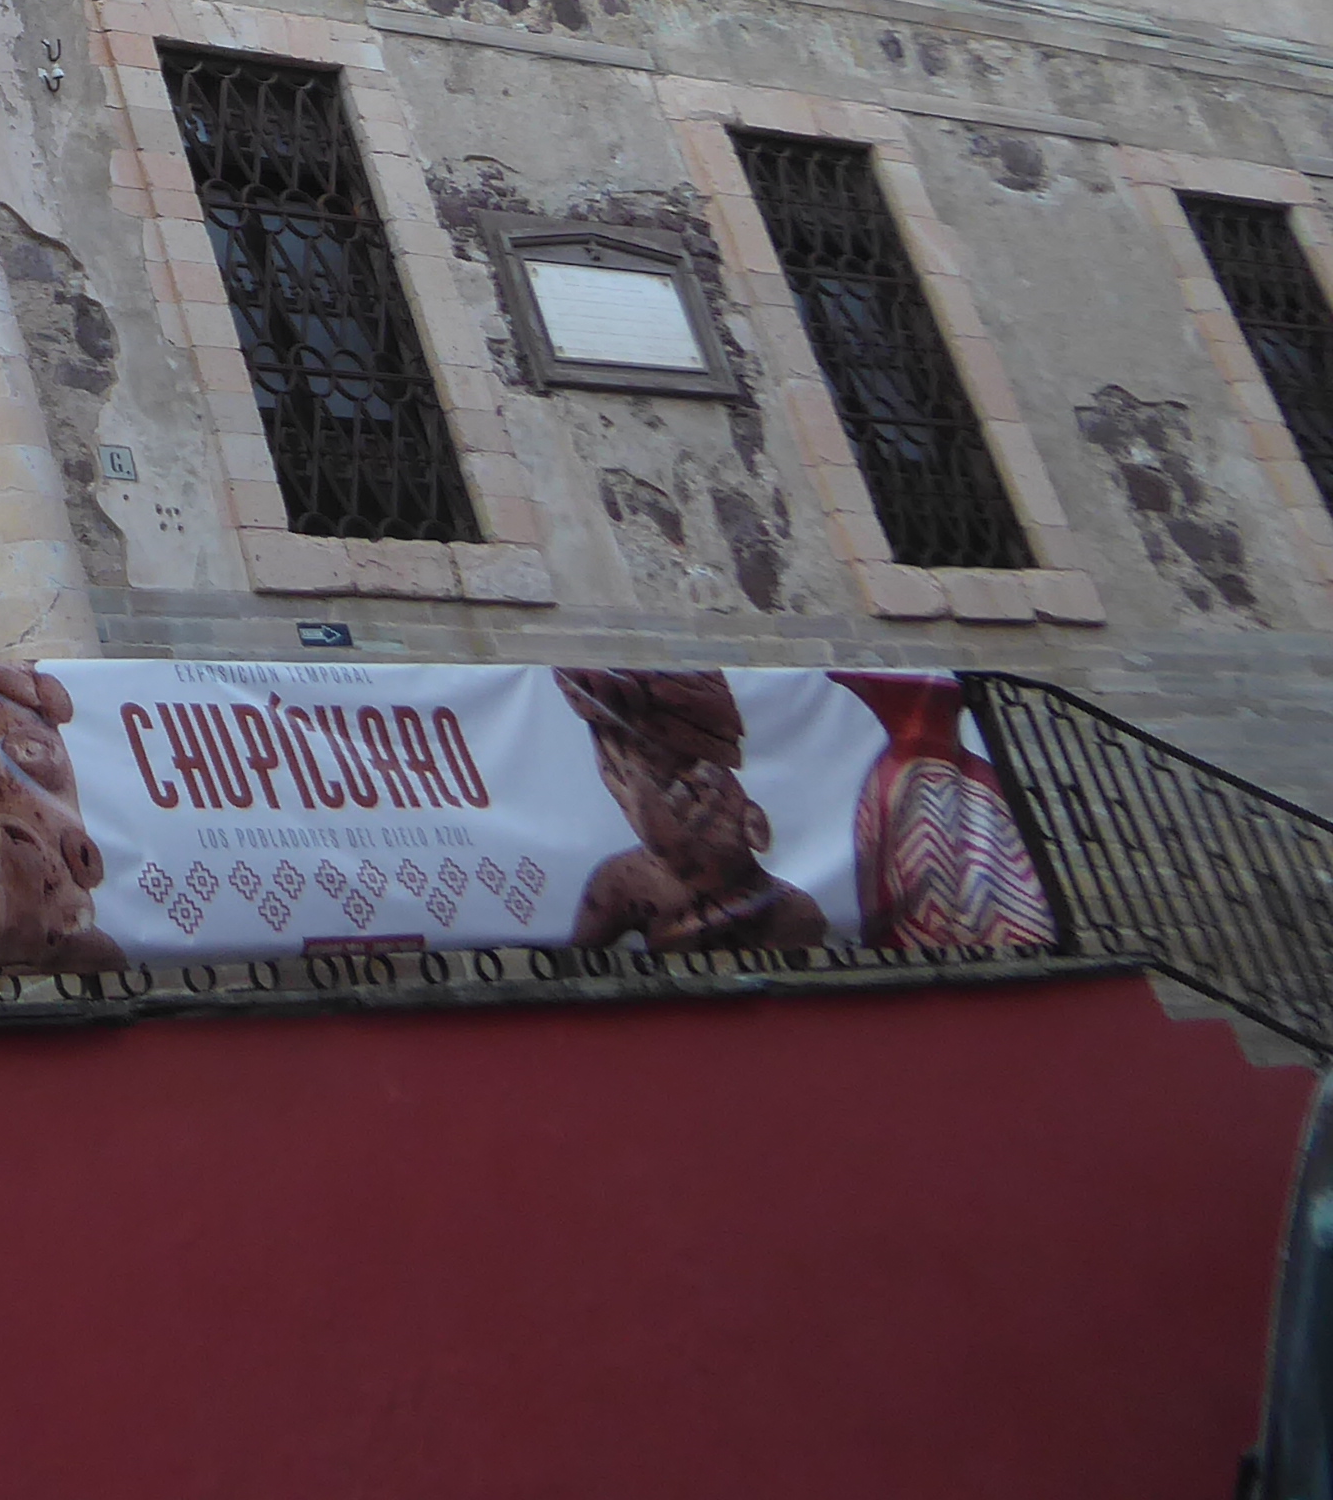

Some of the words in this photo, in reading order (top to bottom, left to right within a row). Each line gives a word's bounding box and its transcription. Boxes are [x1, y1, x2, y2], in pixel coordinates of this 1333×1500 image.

[174, 663, 281, 684] EXPOSICIÓN
[287, 665, 374, 685] TEMPORAL
[119, 690, 490, 811] CHUPÍCUARO
[197, 828, 229, 849] LOS
[233, 828, 338, 849] POBLADORES
[344, 827, 378, 849] DEL
[382, 827, 428, 848] CIELO
[434, 826, 475, 848] AZUL
